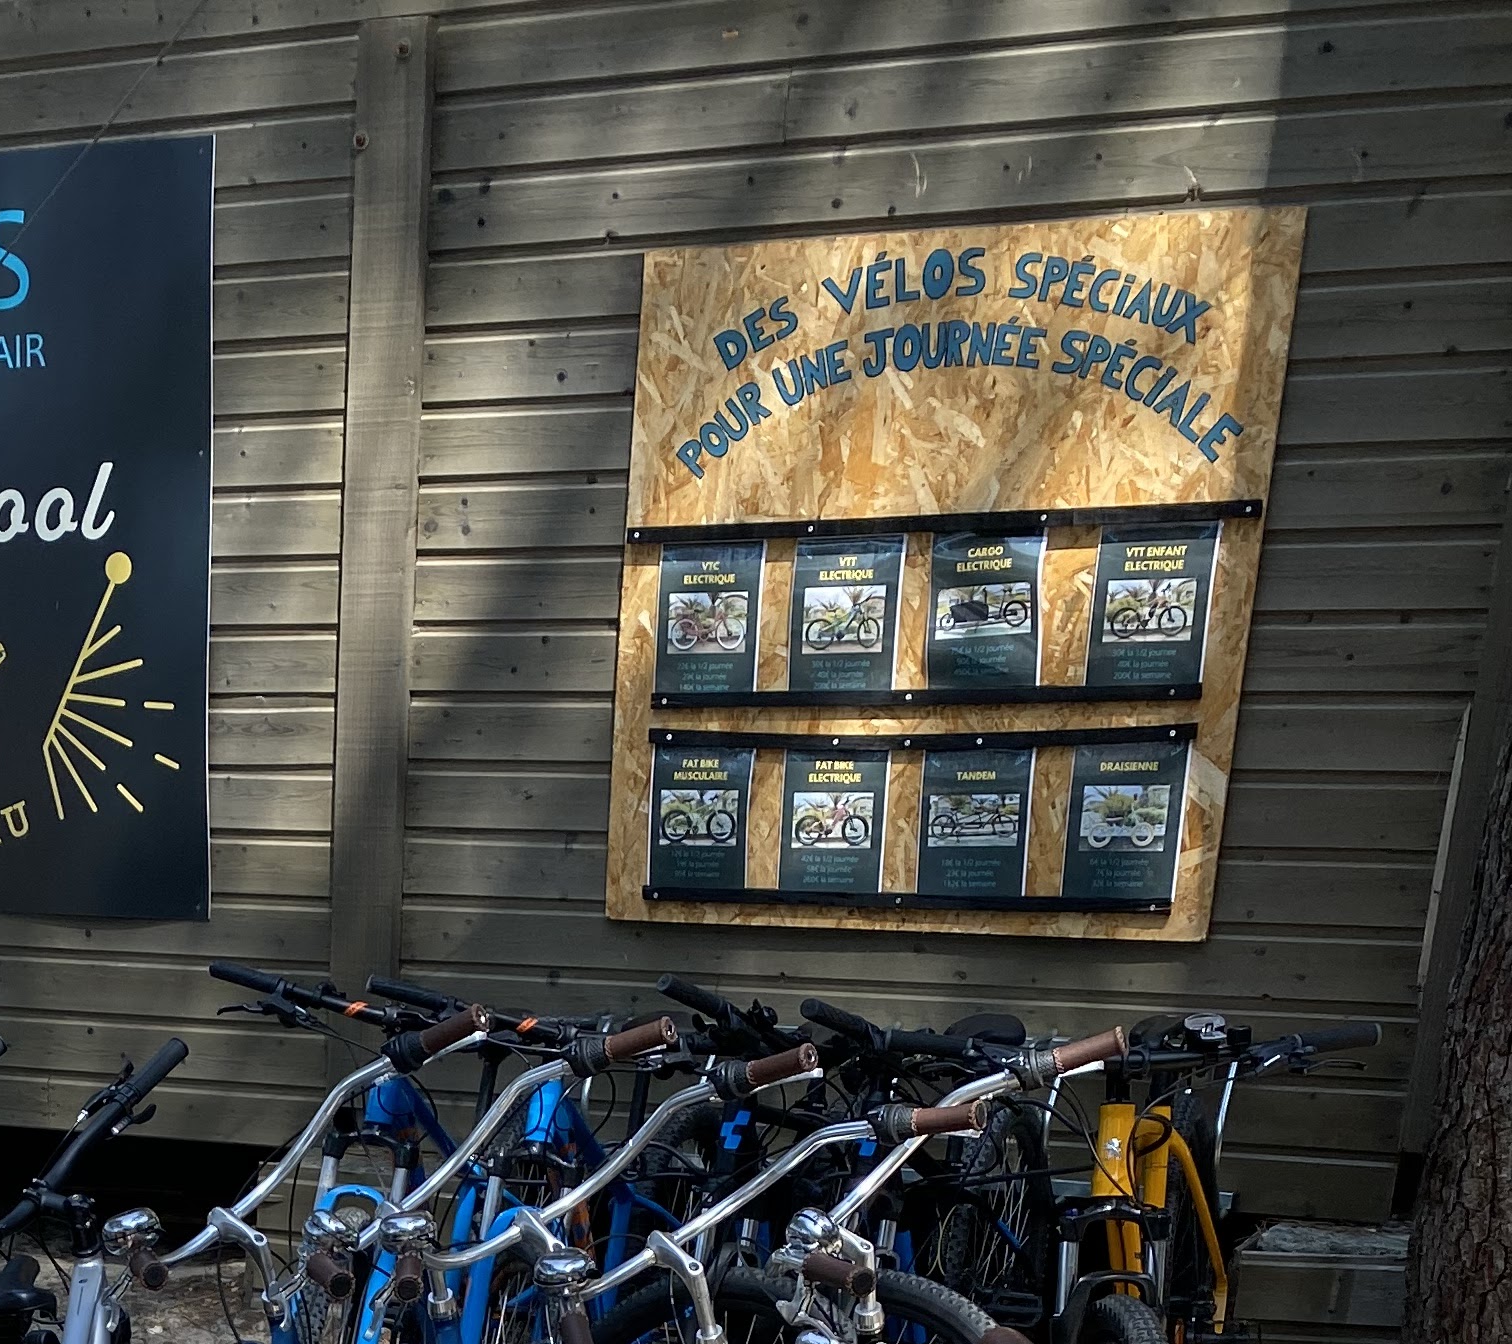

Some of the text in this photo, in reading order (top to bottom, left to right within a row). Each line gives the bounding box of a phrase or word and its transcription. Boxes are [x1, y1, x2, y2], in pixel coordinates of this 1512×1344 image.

[712, 296, 799, 371] DES
[821, 246, 986, 317] VÉLOS
[675, 383, 772, 480] POUR
[771, 339, 853, 409] UNE
[863, 316, 1049, 379] JOURNÉE
[967, 546, 1004, 558] CARGO
[1126, 545, 1187, 557] VTT ENFANT
[701, 561, 721, 571] VTC
[839, 557, 857, 567] VTT
[956, 558, 1013, 573] ELECTRIQUE
[1124, 560, 1185, 572] ELECTRIQUE
[683, 573, 736, 585] ELECTRIQUE
[819, 569, 874, 581] ELECTRIQUE
[682, 759, 719, 769] FAT BIKE
[815, 760, 854, 771] FAT BIKE
[1100, 761, 1159, 772] DRAISIENNE
[673, 771, 729, 781] MUSCULAIRE
[808, 773, 862, 785] ELECTRIQUE
[956, 771, 996, 781] TANDEM
